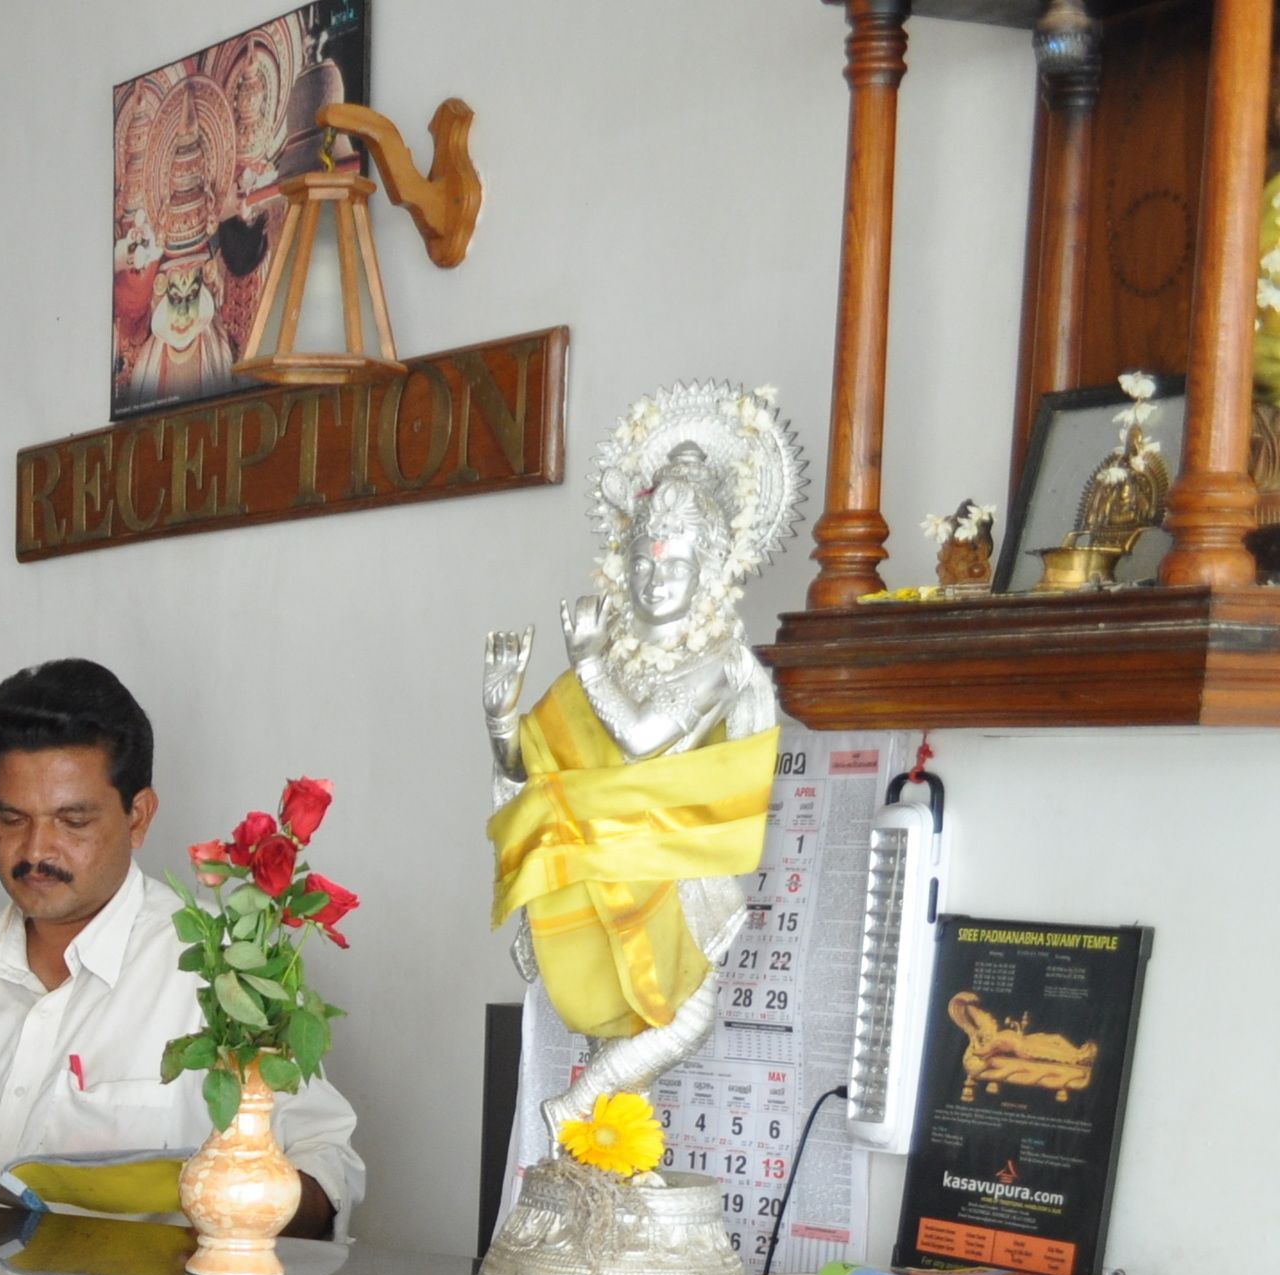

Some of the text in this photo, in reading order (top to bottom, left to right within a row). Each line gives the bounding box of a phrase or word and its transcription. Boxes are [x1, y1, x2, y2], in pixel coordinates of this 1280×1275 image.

[20, 340, 543, 551] RECEPTION
[794, 787, 817, 798] APRIL
[796, 834, 805, 854] 1
[758, 872, 768, 892] 7
[777, 912, 799, 932] 15
[957, 927, 1120, 951] SREE PADMANABHA SWAMY TEMPLE
[739, 949, 792, 971] 21 22
[732, 987, 788, 1010] 28 29
[767, 1071, 787, 1083] MAY
[661, 1109, 781, 1140] 3 4 5 6
[663, 1147, 785, 1179] 0 11 12 13
[942, 1170, 1064, 1205] kasavupura.com
[721, 1193, 782, 1218] 19 20
